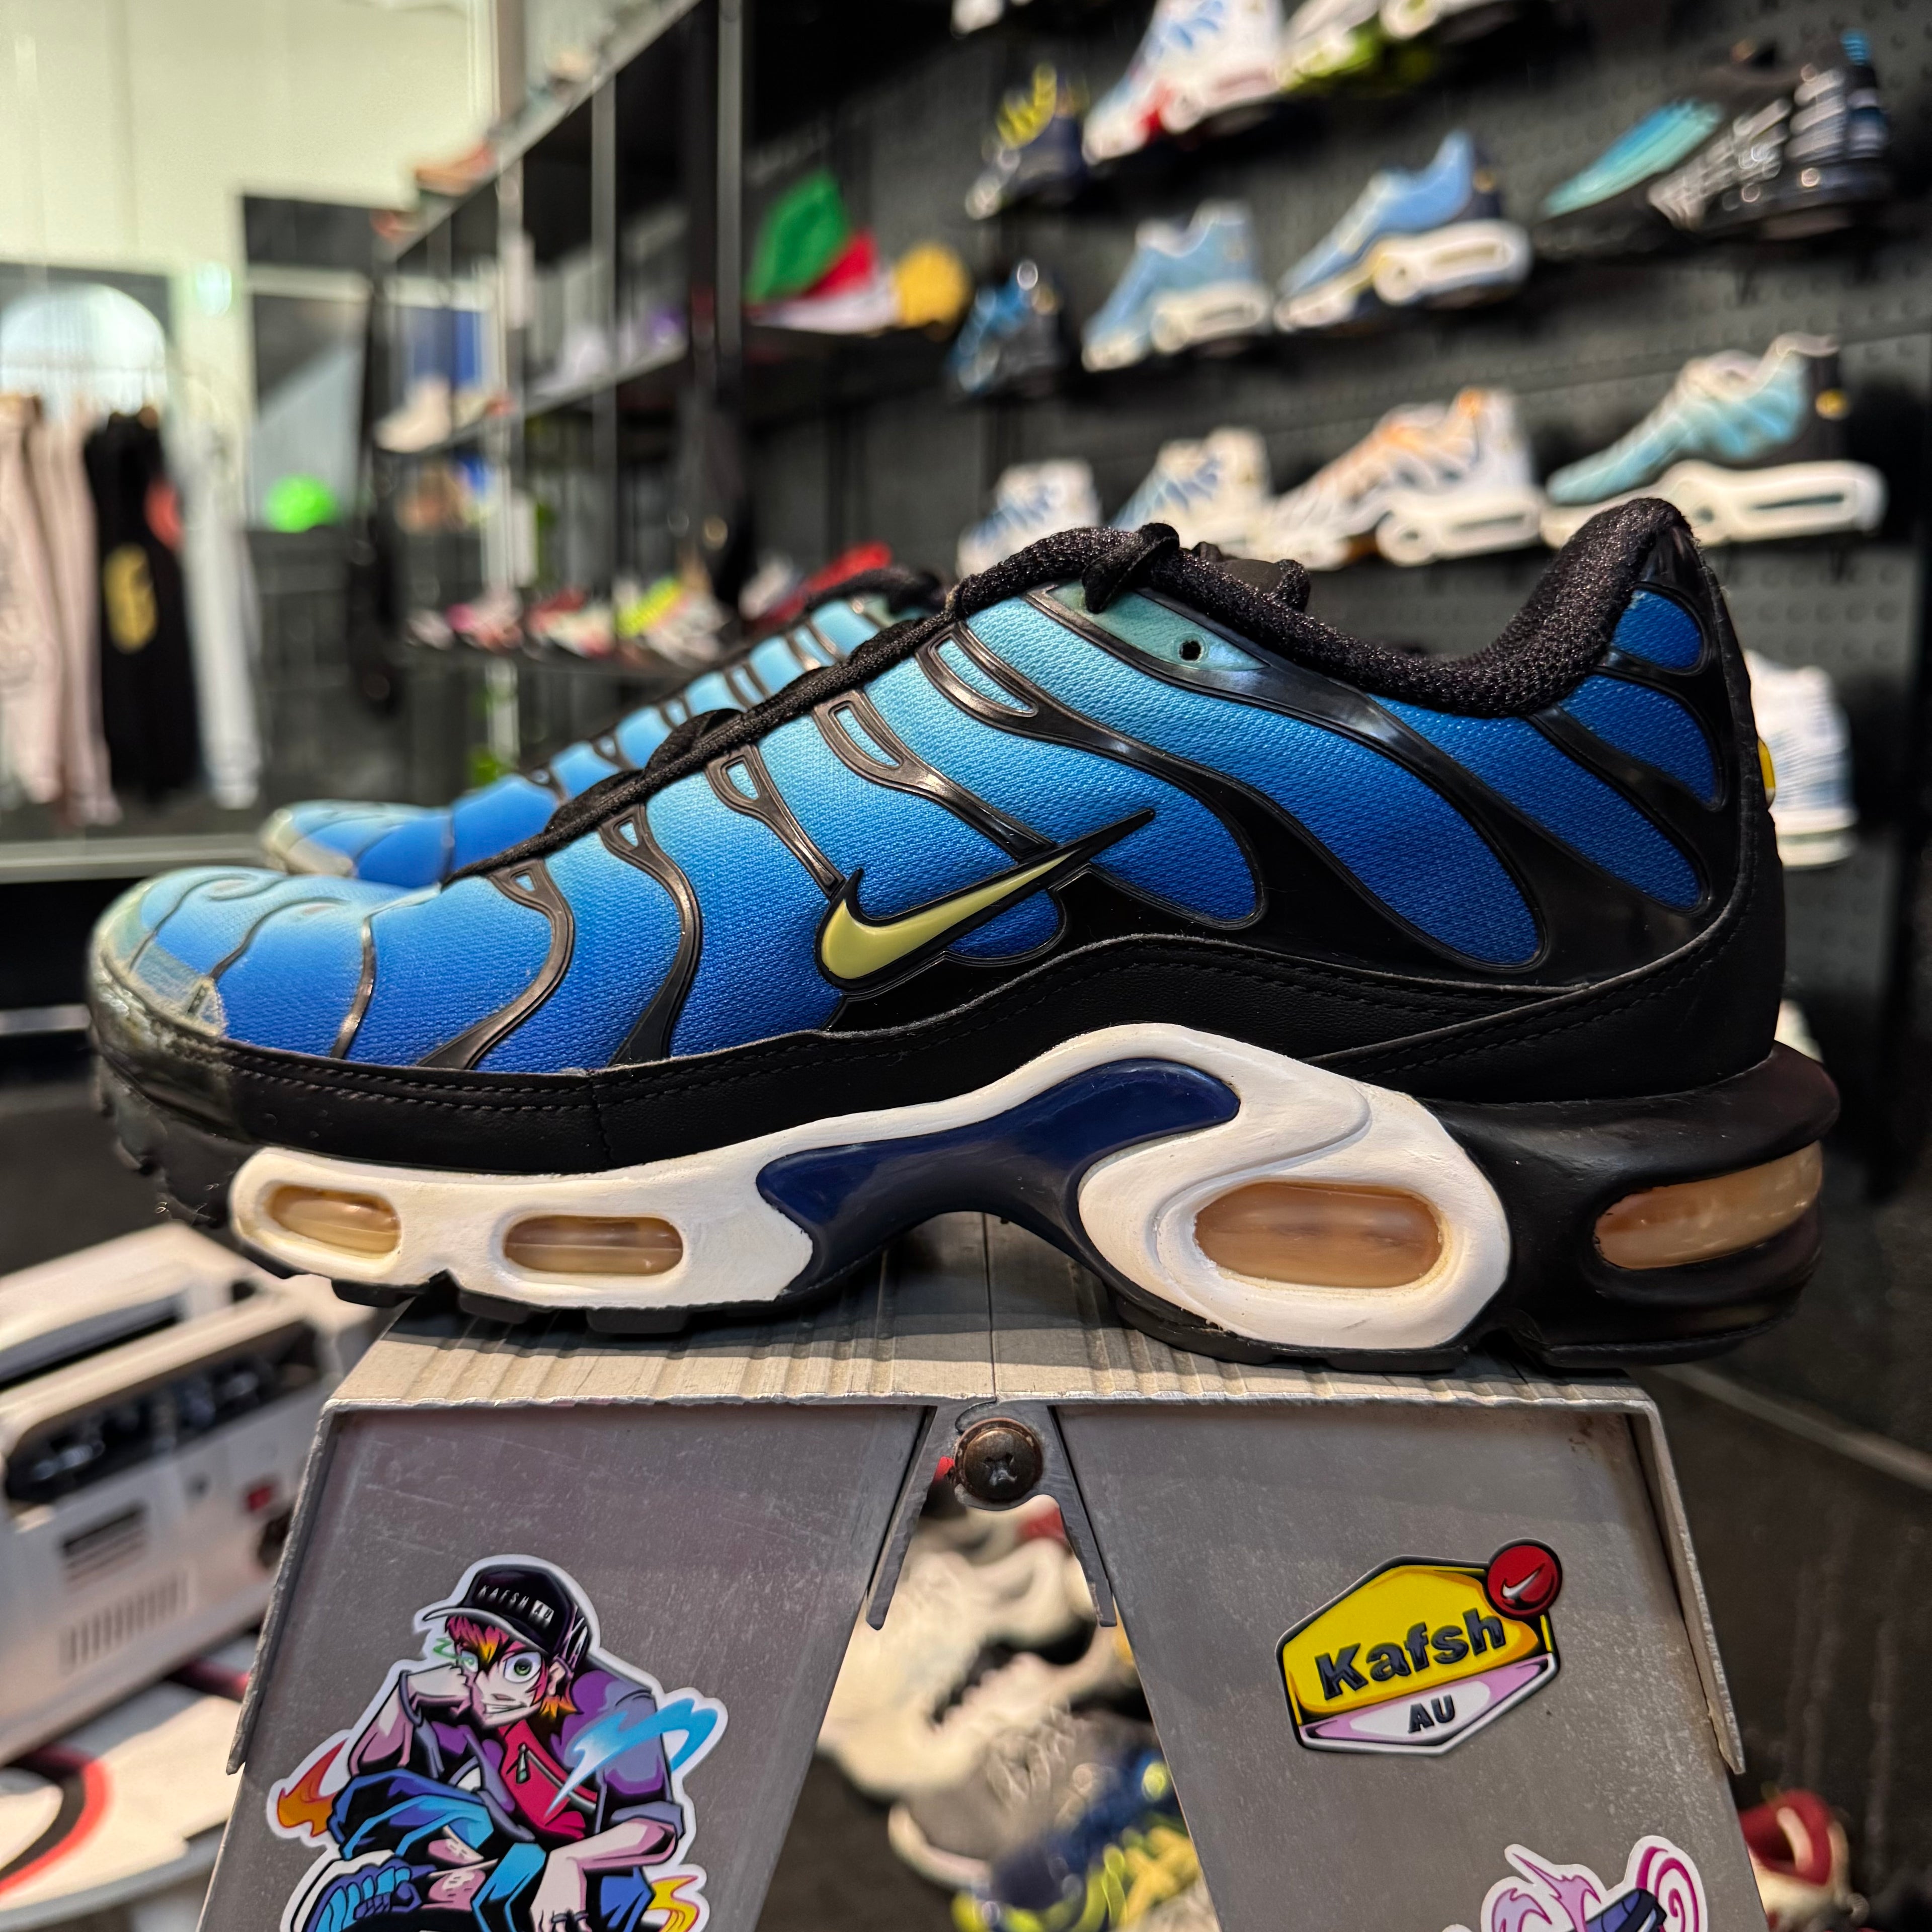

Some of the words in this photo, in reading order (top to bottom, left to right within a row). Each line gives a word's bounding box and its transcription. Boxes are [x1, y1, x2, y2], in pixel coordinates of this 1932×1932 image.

[477, 1585, 529, 1610] KAFSH
[533, 1603, 553, 1619] AU
[1315, 1608, 1506, 1700] Kafsh
[1408, 1694, 1456, 1734] AU
